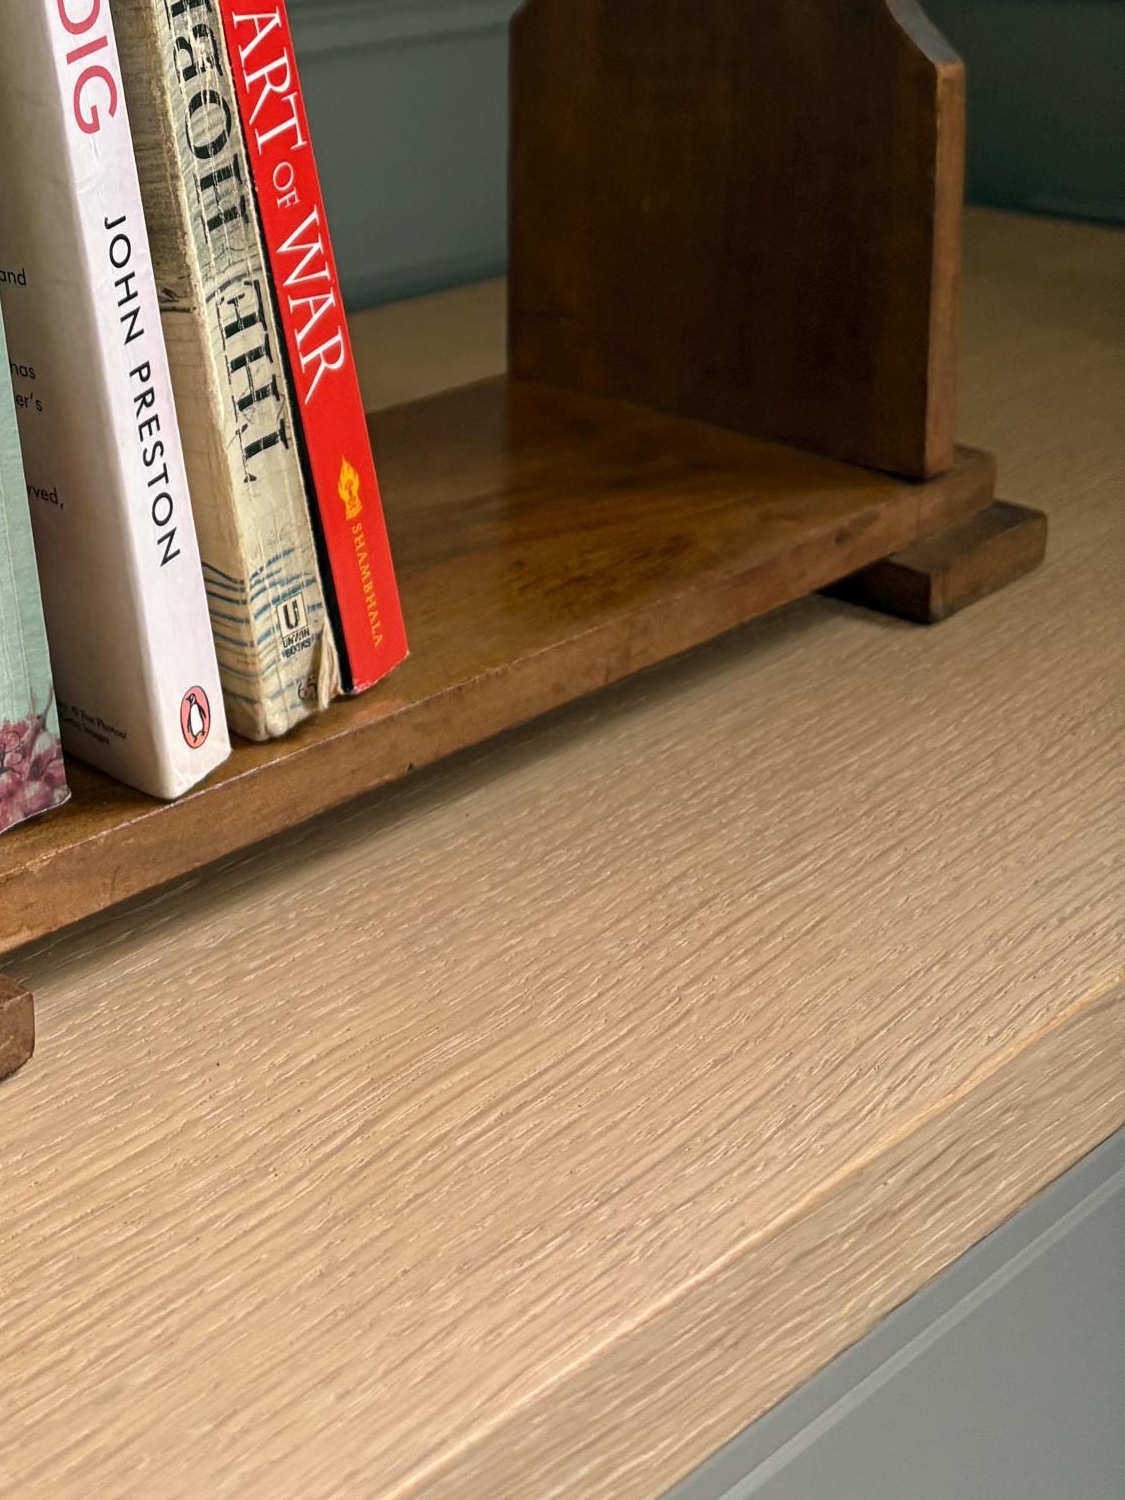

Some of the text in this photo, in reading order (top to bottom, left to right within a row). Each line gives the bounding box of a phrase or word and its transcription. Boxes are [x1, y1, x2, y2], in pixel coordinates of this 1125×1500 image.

[232, 7, 307, 155] ART
[273, 161, 300, 209] OF
[276, 204, 346, 405] WAR
[104, 215, 181, 568] JOHN PRESTON
[215, 278, 289, 485] THE
[282, 598, 300, 630] U
[351, 522, 383, 648] SHAMBHALA
